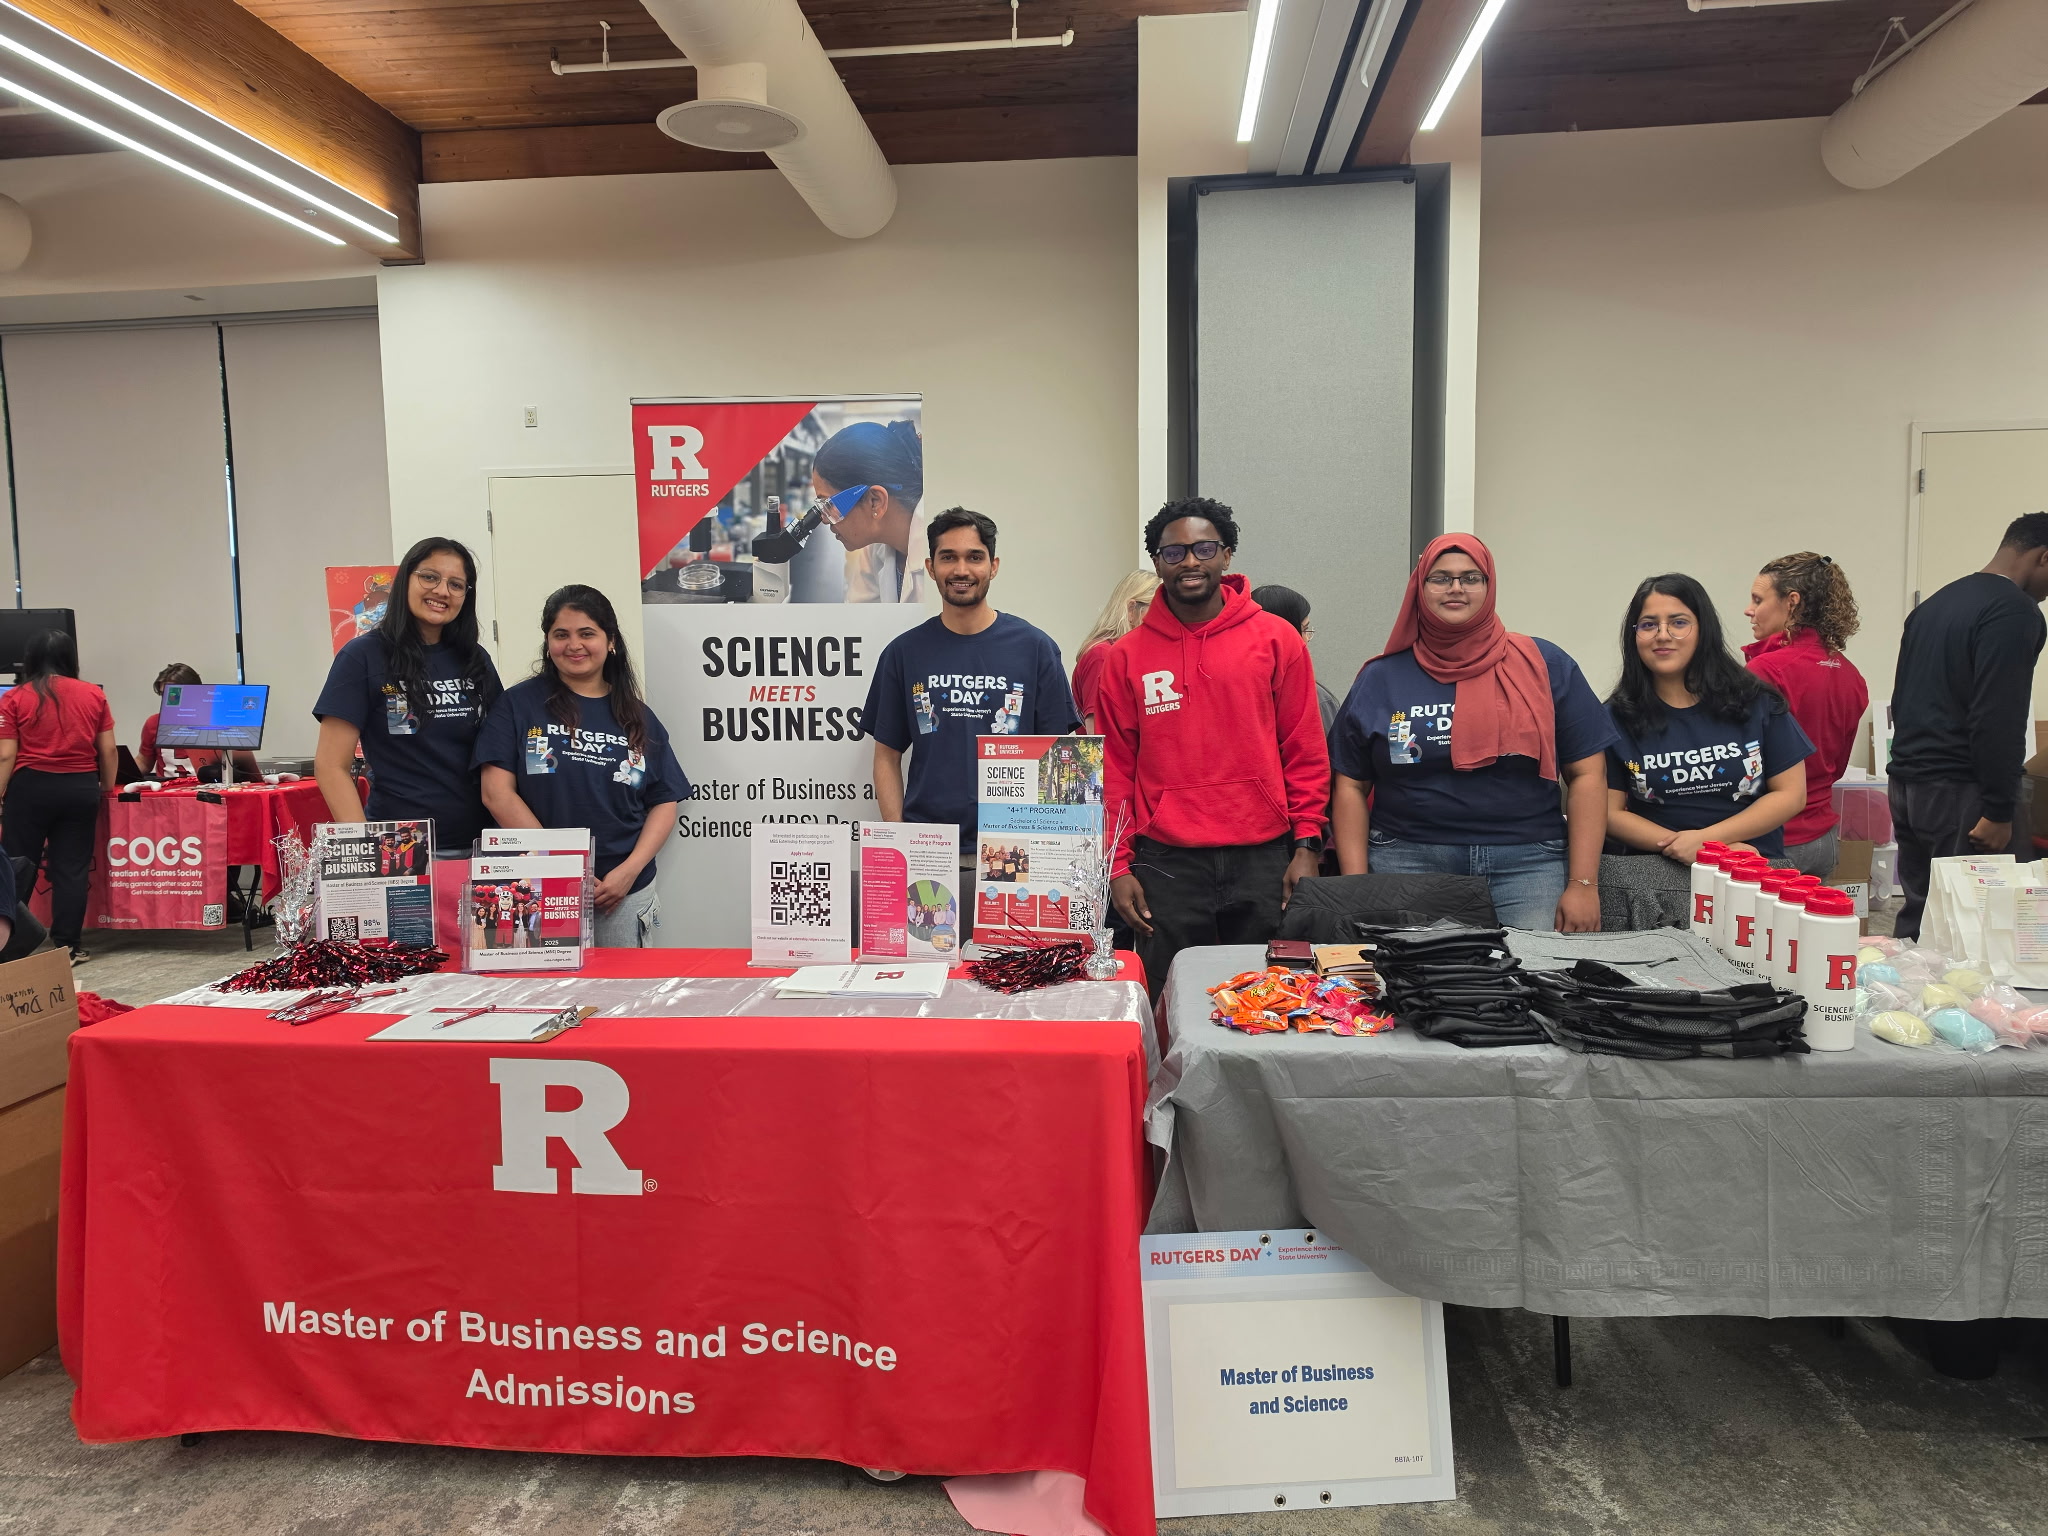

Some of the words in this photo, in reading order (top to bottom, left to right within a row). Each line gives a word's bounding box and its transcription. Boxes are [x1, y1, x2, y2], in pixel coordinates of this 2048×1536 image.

[648, 425, 708, 480] R
[651, 484, 709, 497] RUTGERS
[702, 636, 862, 677] SCIENCE
[928, 674, 1008, 690] RUTGERS
[1142, 670, 1179, 705] R
[749, 685, 816, 702] MEETS
[951, 690, 984, 705] DAY
[1145, 702, 1180, 715] RUTGERS
[702, 707, 865, 741] BUSINESS
[547, 724, 629, 746] RUTGERS
[571, 738, 606, 754] DAY
[1643, 742, 1742, 770] RUTGERS
[988, 767, 1025, 779] SCIENCE
[1672, 764, 1716, 784] DAY
[684, 780, 739, 800] aster
[747, 778, 766, 800] of
[773, 778, 856, 800] Business
[987, 786, 1024, 797] BUSINESS
[678, 815, 752, 838] Science
[489, 837, 499, 845] R
[107, 836, 202, 866] COGS
[178, 869, 203, 878] Society
[325, 861, 376, 875] BUSINESS
[480, 866, 490, 874] R
[544, 896, 579, 906] SCIENCE
[544, 910, 579, 920] BUSINESS
[1826, 955, 1857, 990] R
[1814, 1005, 1847, 1013] SCIENCE
[489, 1058, 643, 1196] R
[1150, 1250, 1225, 1266] RUTGERS
[1230, 1248, 1262, 1263] DAY
[263, 1301, 394, 1341] Master
[407, 1310, 446, 1342] of
[460, 1310, 642, 1351] Business
[656, 1326, 725, 1359] and
[742, 1320, 898, 1371] Science
[1220, 1368, 1278, 1386] Master
[1281, 1366, 1298, 1383] of
[1301, 1364, 1374, 1382] Business
[466, 1369, 695, 1415] Admissions
[1249, 1397, 1280, 1414] and
[1284, 1395, 1348, 1413] Science
